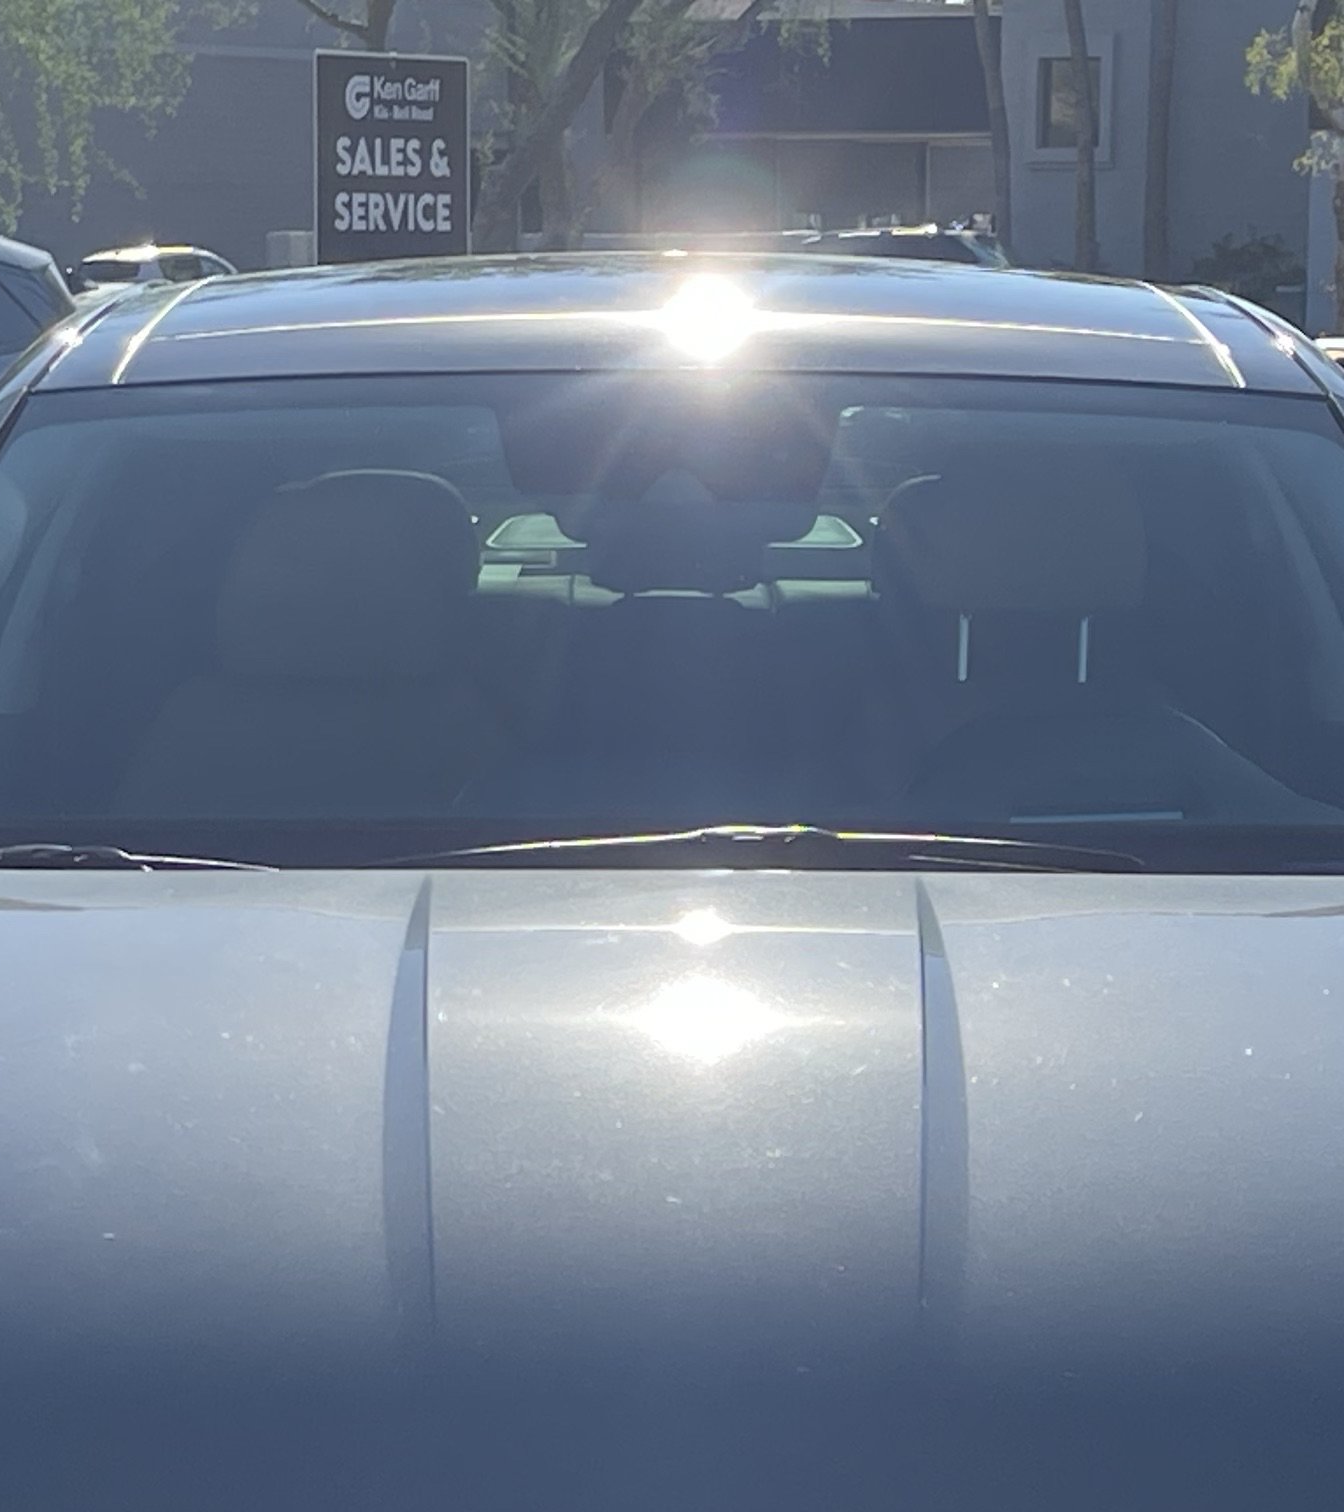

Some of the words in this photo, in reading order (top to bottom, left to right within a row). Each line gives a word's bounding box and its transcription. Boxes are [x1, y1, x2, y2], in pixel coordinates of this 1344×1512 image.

[373, 75, 402, 100] Ken
[336, 136, 422, 177] SALES
[429, 138, 451, 178] &
[334, 191, 452, 232] SERVICE
